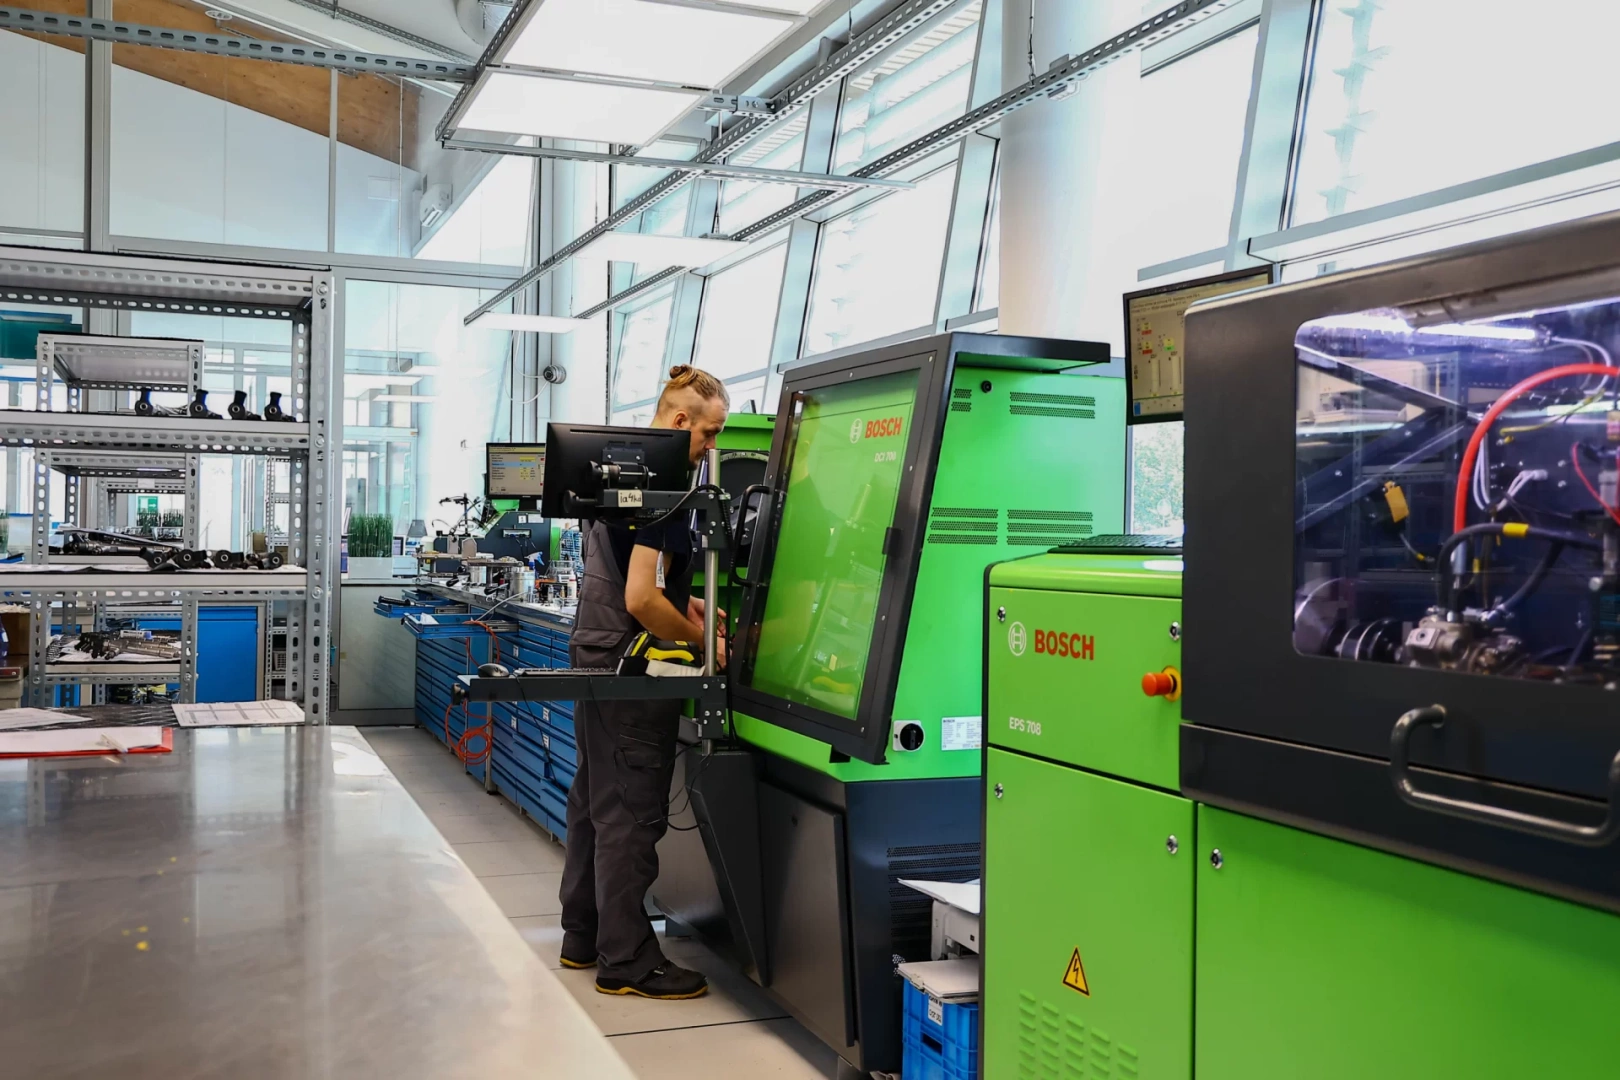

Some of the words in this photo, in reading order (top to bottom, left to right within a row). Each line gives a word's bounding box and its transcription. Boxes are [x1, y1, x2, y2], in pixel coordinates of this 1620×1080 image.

[865, 417, 902, 438] BOSCH
[1034, 629, 1094, 660] BOSCH
[1009, 716, 1025, 731] EPS
[1026, 720, 1041, 735] 708
